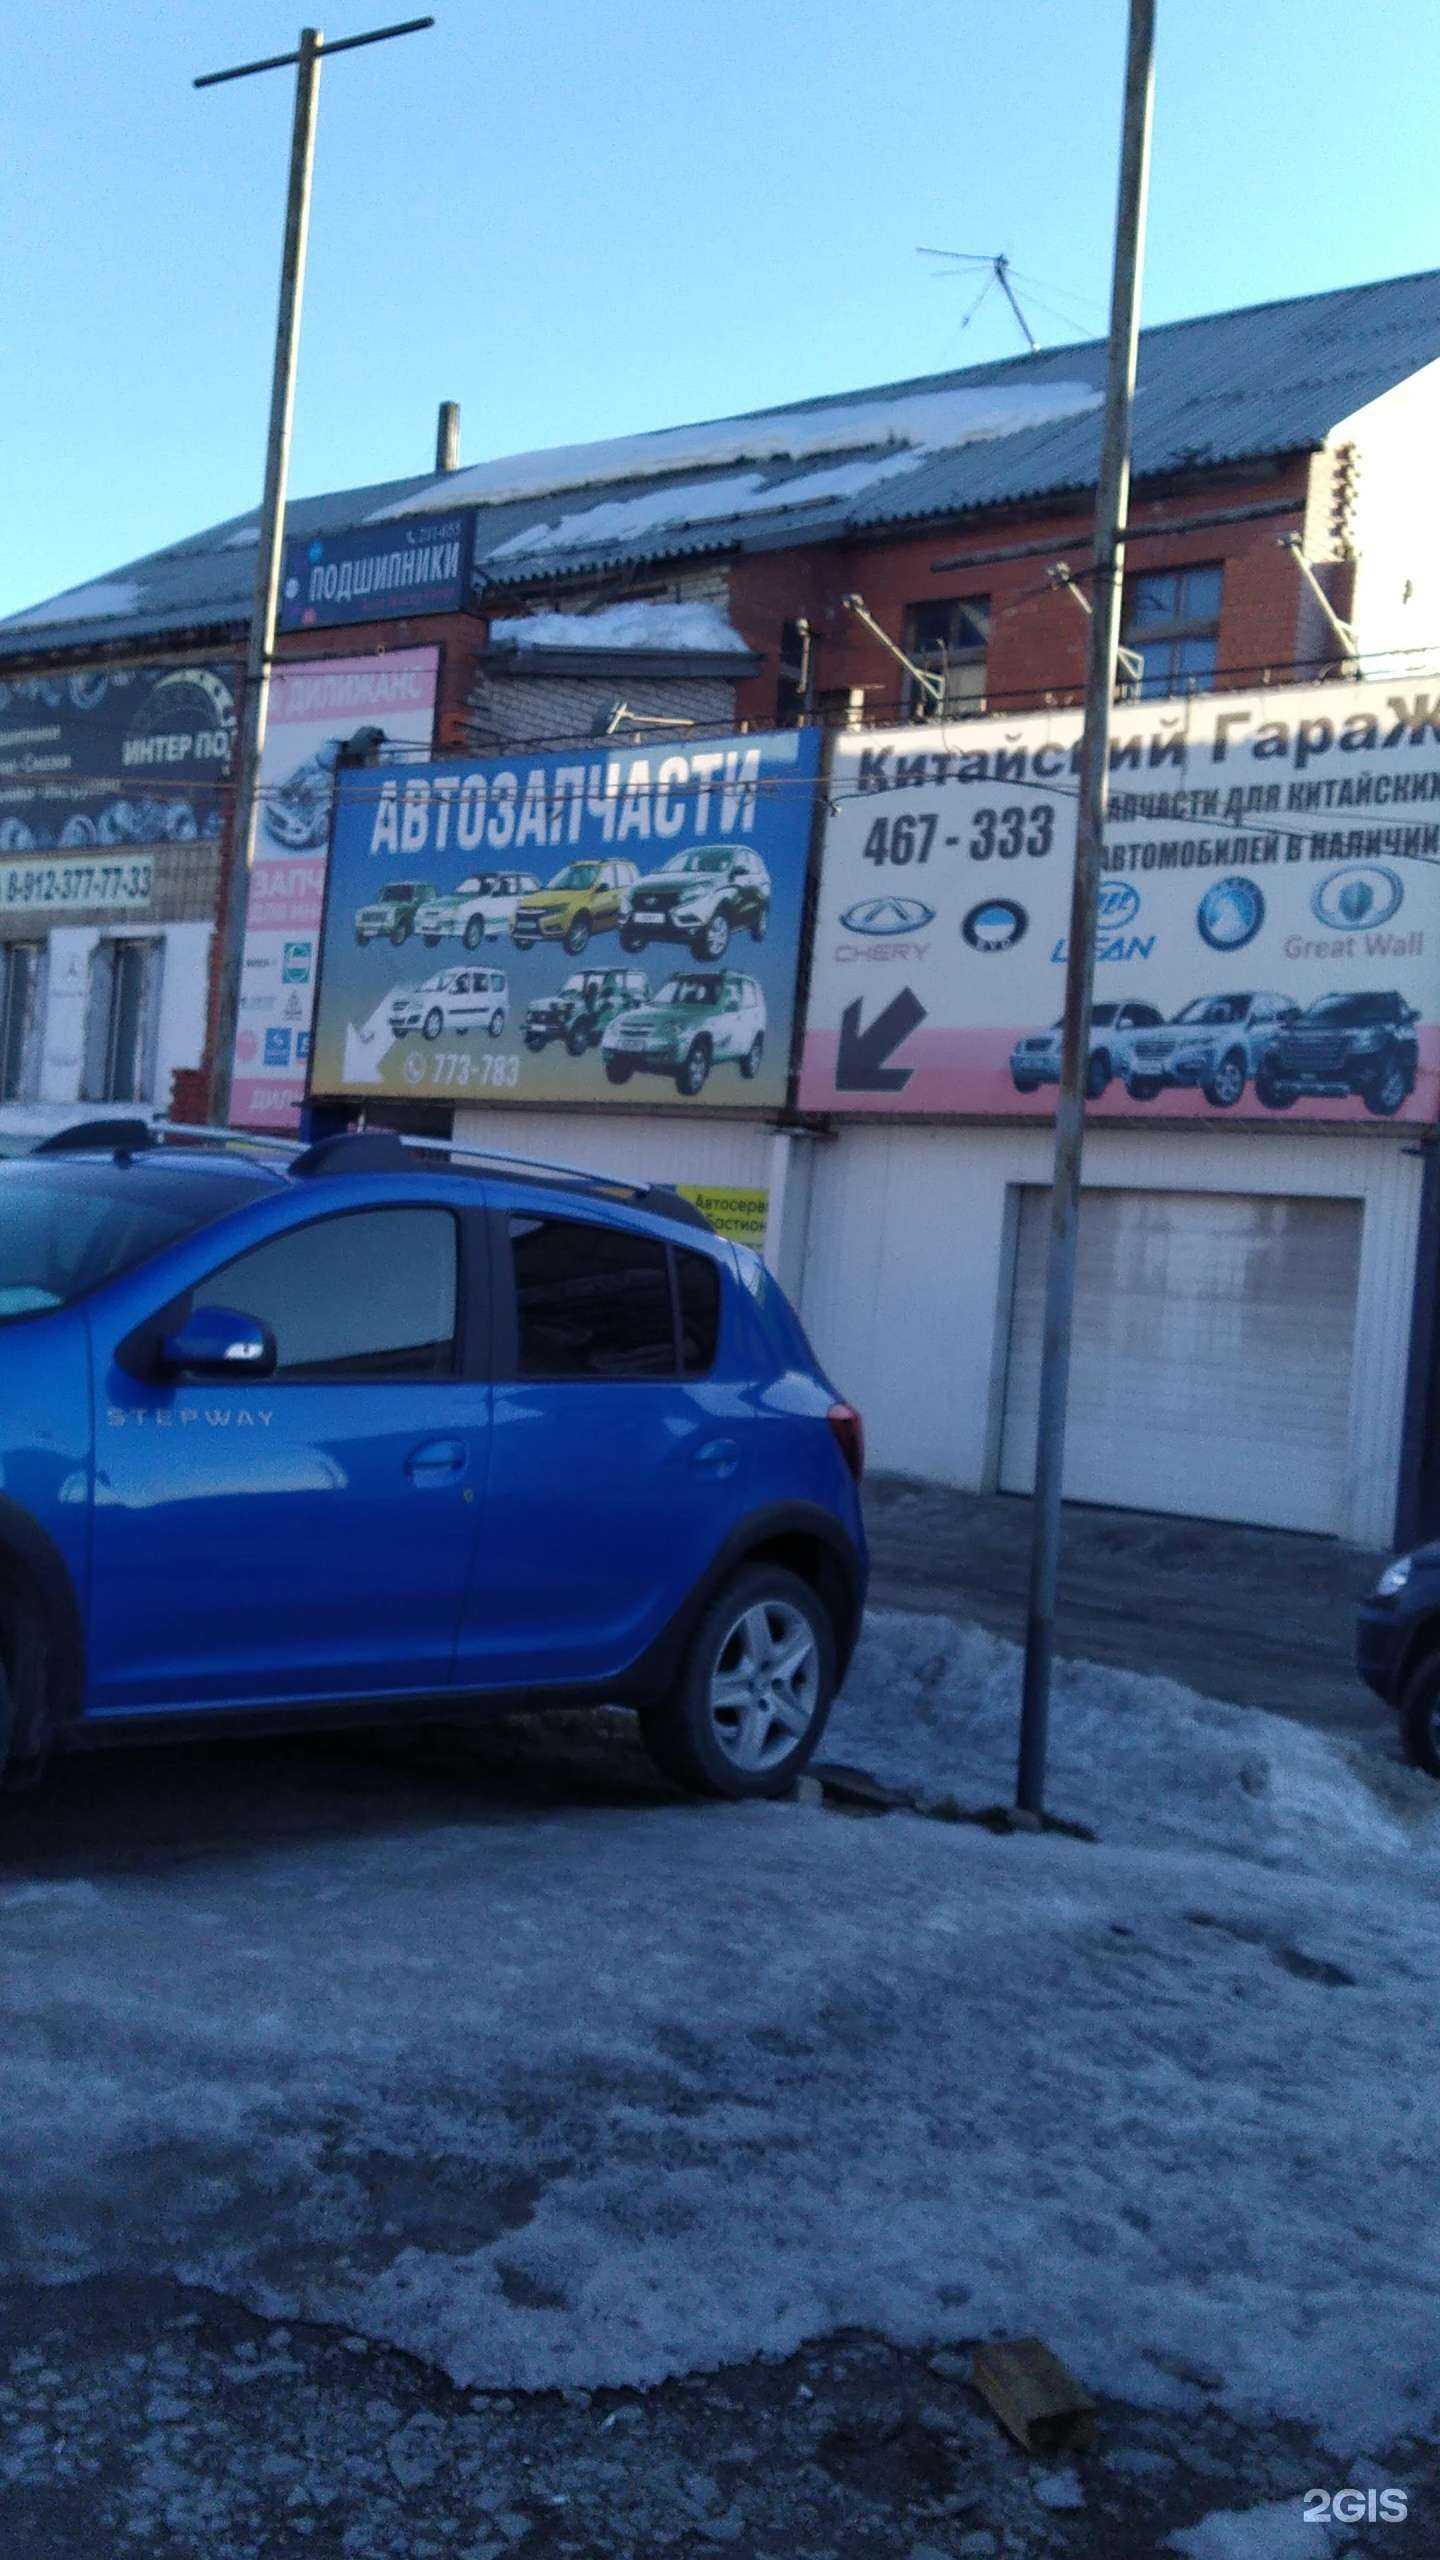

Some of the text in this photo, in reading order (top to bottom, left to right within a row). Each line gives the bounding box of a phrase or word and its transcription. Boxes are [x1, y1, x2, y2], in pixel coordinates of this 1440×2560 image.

[308, 541, 460, 604] ПОДШИПНИКИ
[122, 733, 194, 768] ИНТЕР
[370, 748, 762, 855] АВТОЗАПЧАСТИ
[1107, 786, 1218, 822] АПЧАСТИ
[1222, 784, 1281, 821] ДЛЯ
[1286, 832, 1304, 863] В
[833, 941, 932, 963] CHERY
[1283, 930, 1424, 961] Great Wall
[432, 1053, 521, 1088] 773-783
[107, 1408, 272, 1427] STEPWAY
